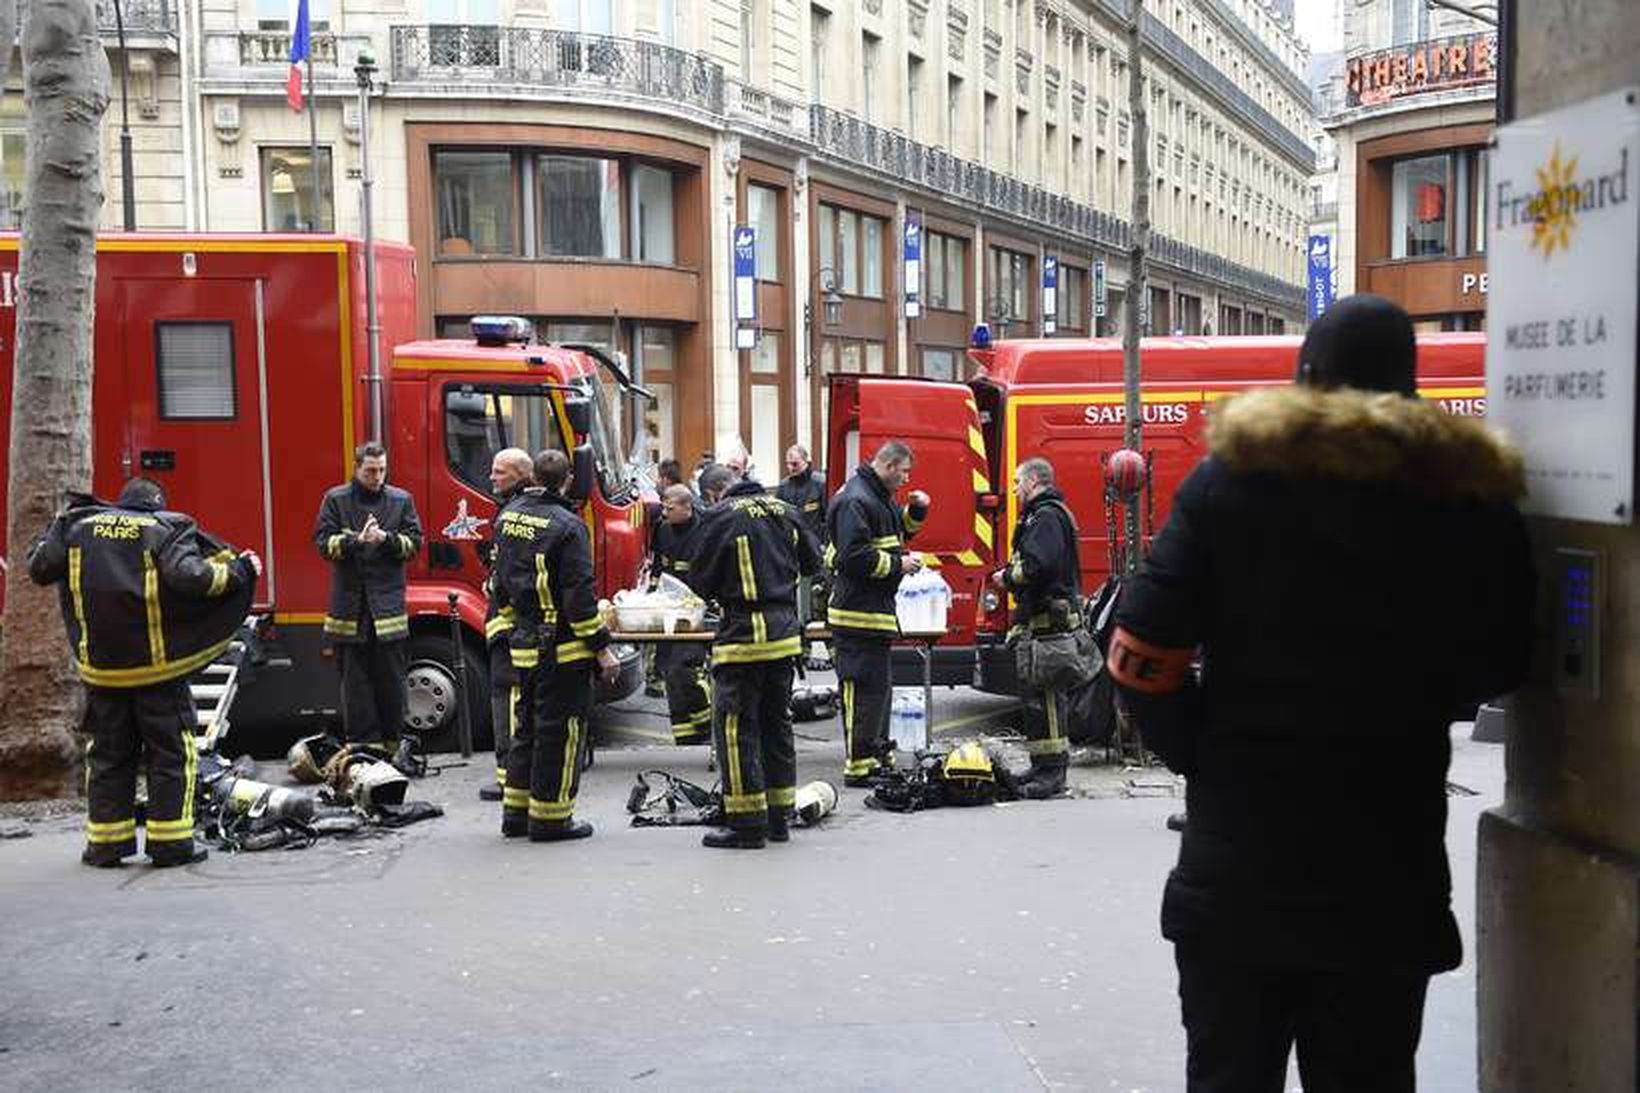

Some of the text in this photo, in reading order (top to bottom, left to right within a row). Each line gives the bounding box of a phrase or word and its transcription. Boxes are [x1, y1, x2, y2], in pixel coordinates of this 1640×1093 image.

[1557, 319, 1576, 347] DE
[1584, 315, 1606, 345] LA
[1085, 404, 1188, 424] SAPURS
[93, 524, 140, 539] PARIS
[502, 521, 535, 541] PARIS
